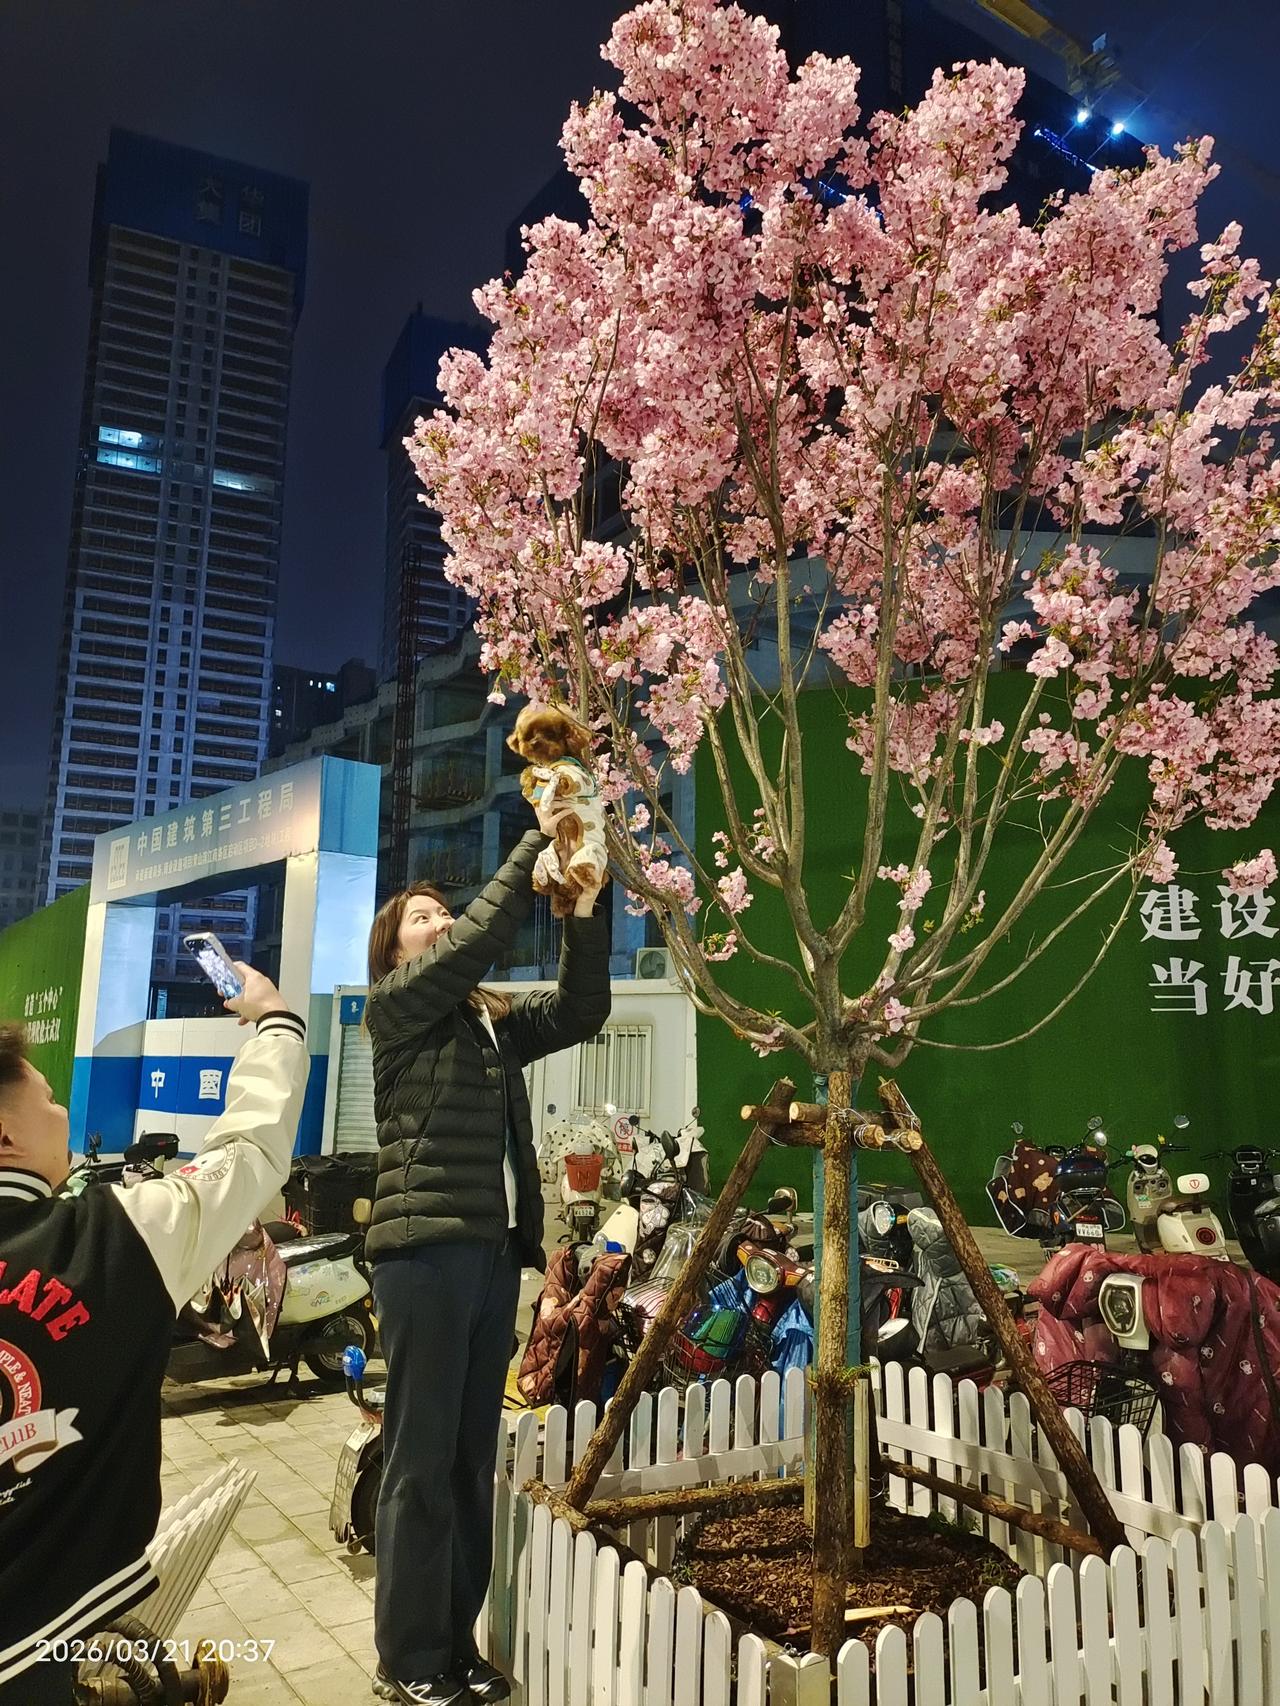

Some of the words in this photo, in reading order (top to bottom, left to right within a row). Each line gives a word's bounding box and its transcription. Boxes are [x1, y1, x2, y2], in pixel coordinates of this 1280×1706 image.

[137, 781, 294, 857] 中国建筑第三工程局
[1137, 884, 1280, 942] 建设
[1149, 955, 1280, 1015] 当好
[14, 1371, 27, 1383] &
[17, 1381, 33, 1415] NEAT
[0, 1423, 37, 1455] LUB
